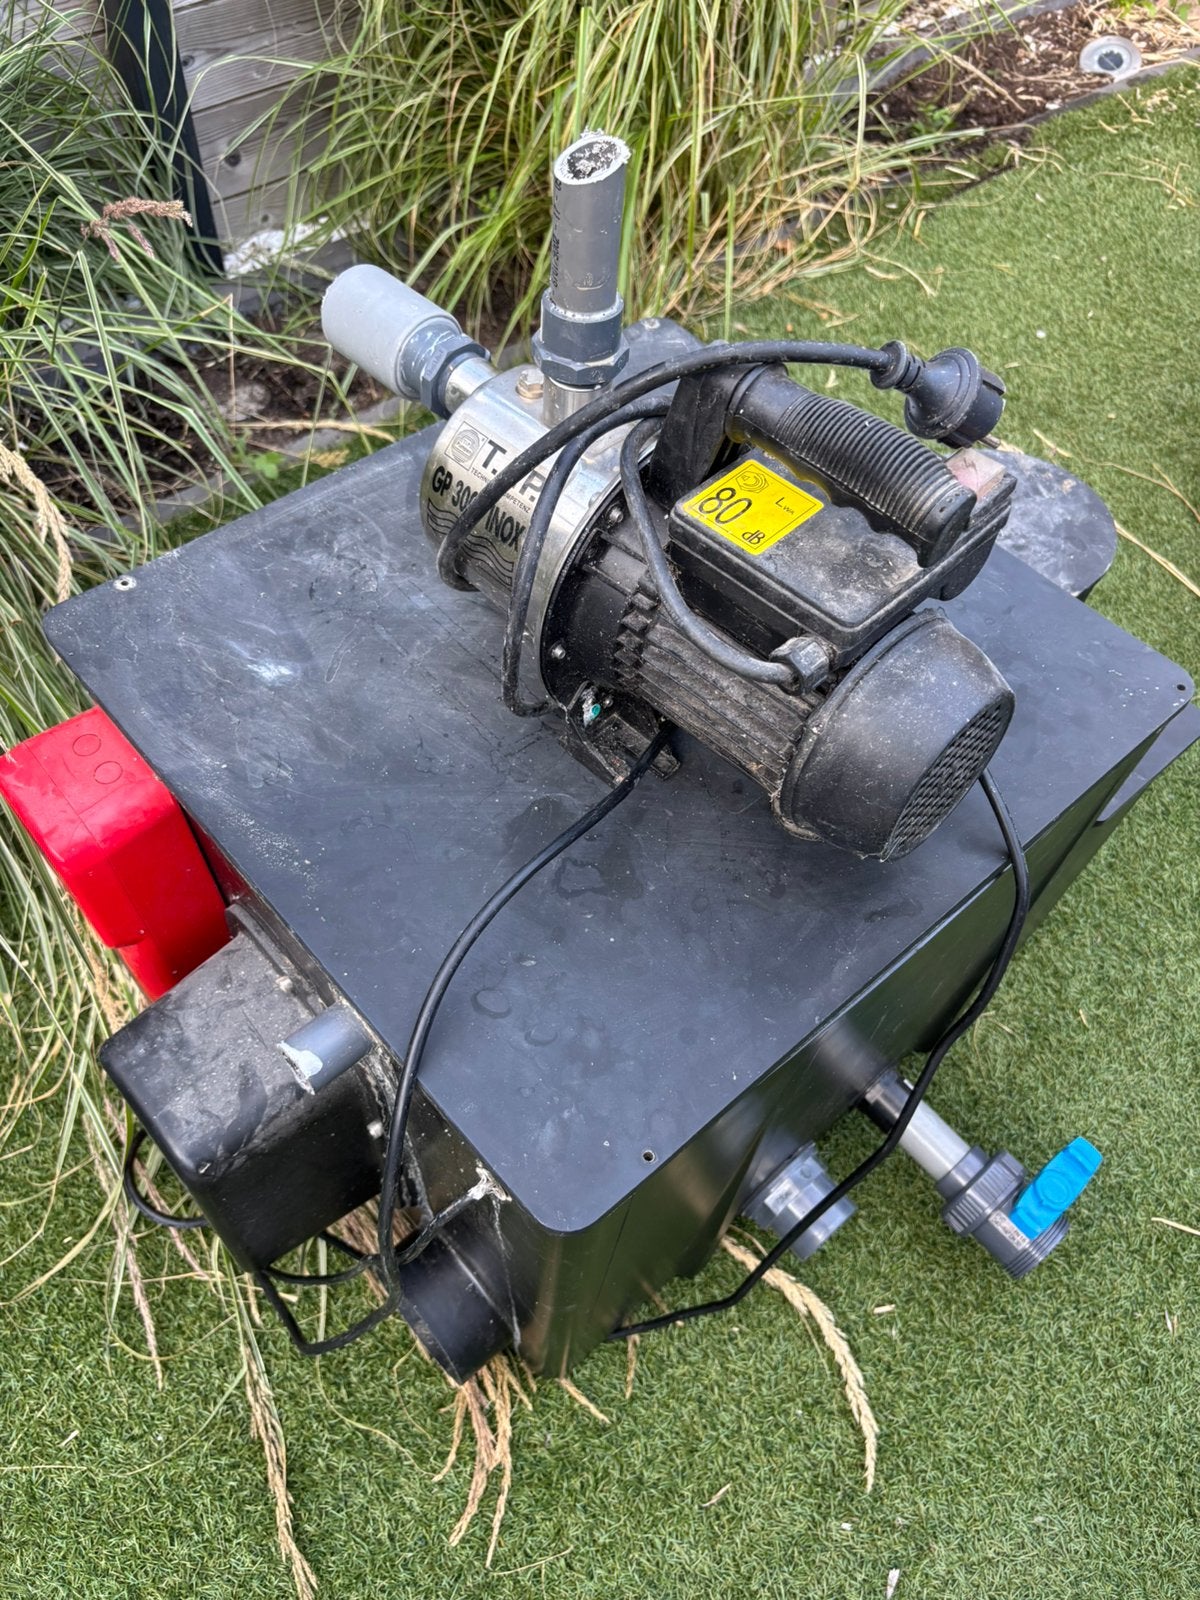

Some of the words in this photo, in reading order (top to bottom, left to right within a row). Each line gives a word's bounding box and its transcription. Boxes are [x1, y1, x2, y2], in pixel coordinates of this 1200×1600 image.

[432, 465, 453, 496] GP
[485, 504, 526, 552] INOX
[698, 487, 753, 525] 80
[742, 529, 766, 545] dB
